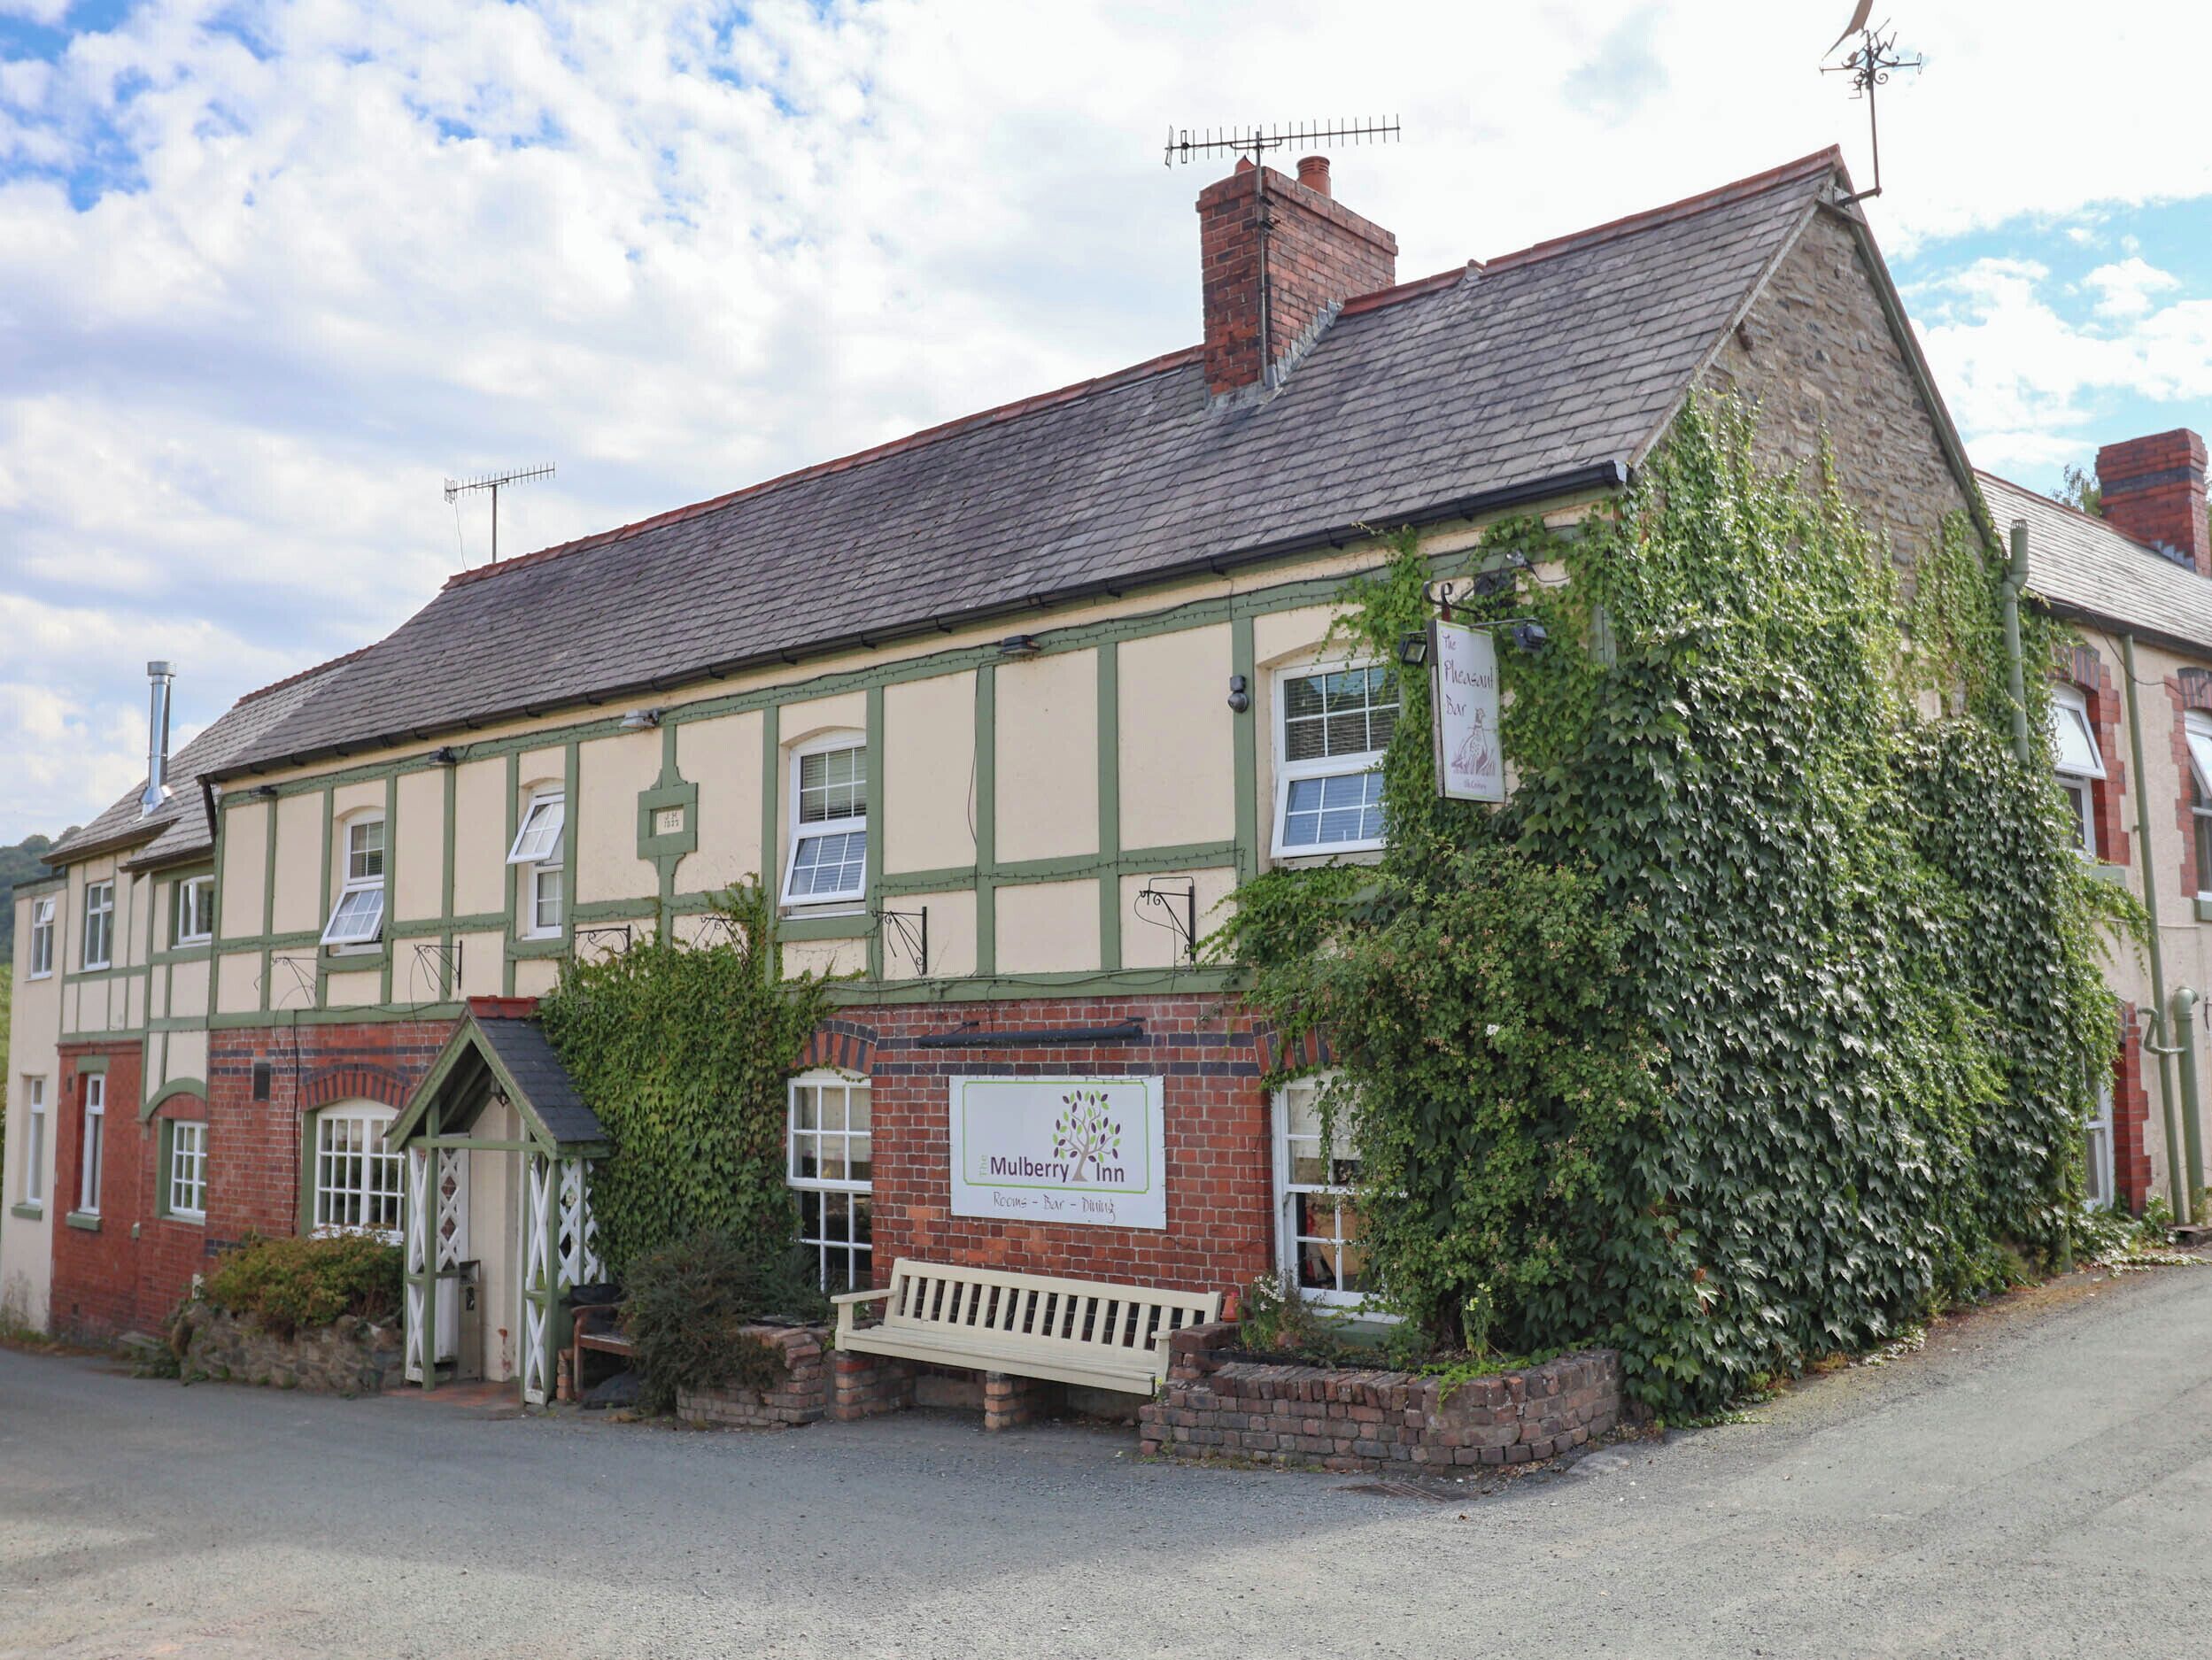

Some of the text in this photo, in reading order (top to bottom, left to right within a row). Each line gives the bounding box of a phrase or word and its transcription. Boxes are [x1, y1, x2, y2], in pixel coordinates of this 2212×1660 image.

[1442, 635, 1457, 651] The
[1443, 659, 1494, 690] Pheasant
[1445, 693, 1467, 716] Bar
[990, 1156, 1070, 1183] Mulberry
[1095, 1162, 1125, 1183] Inn
[994, 1191, 1027, 1208] Rooms
[1043, 1194, 1064, 1211] Bar
[1082, 1197, 1116, 1224] Dining
